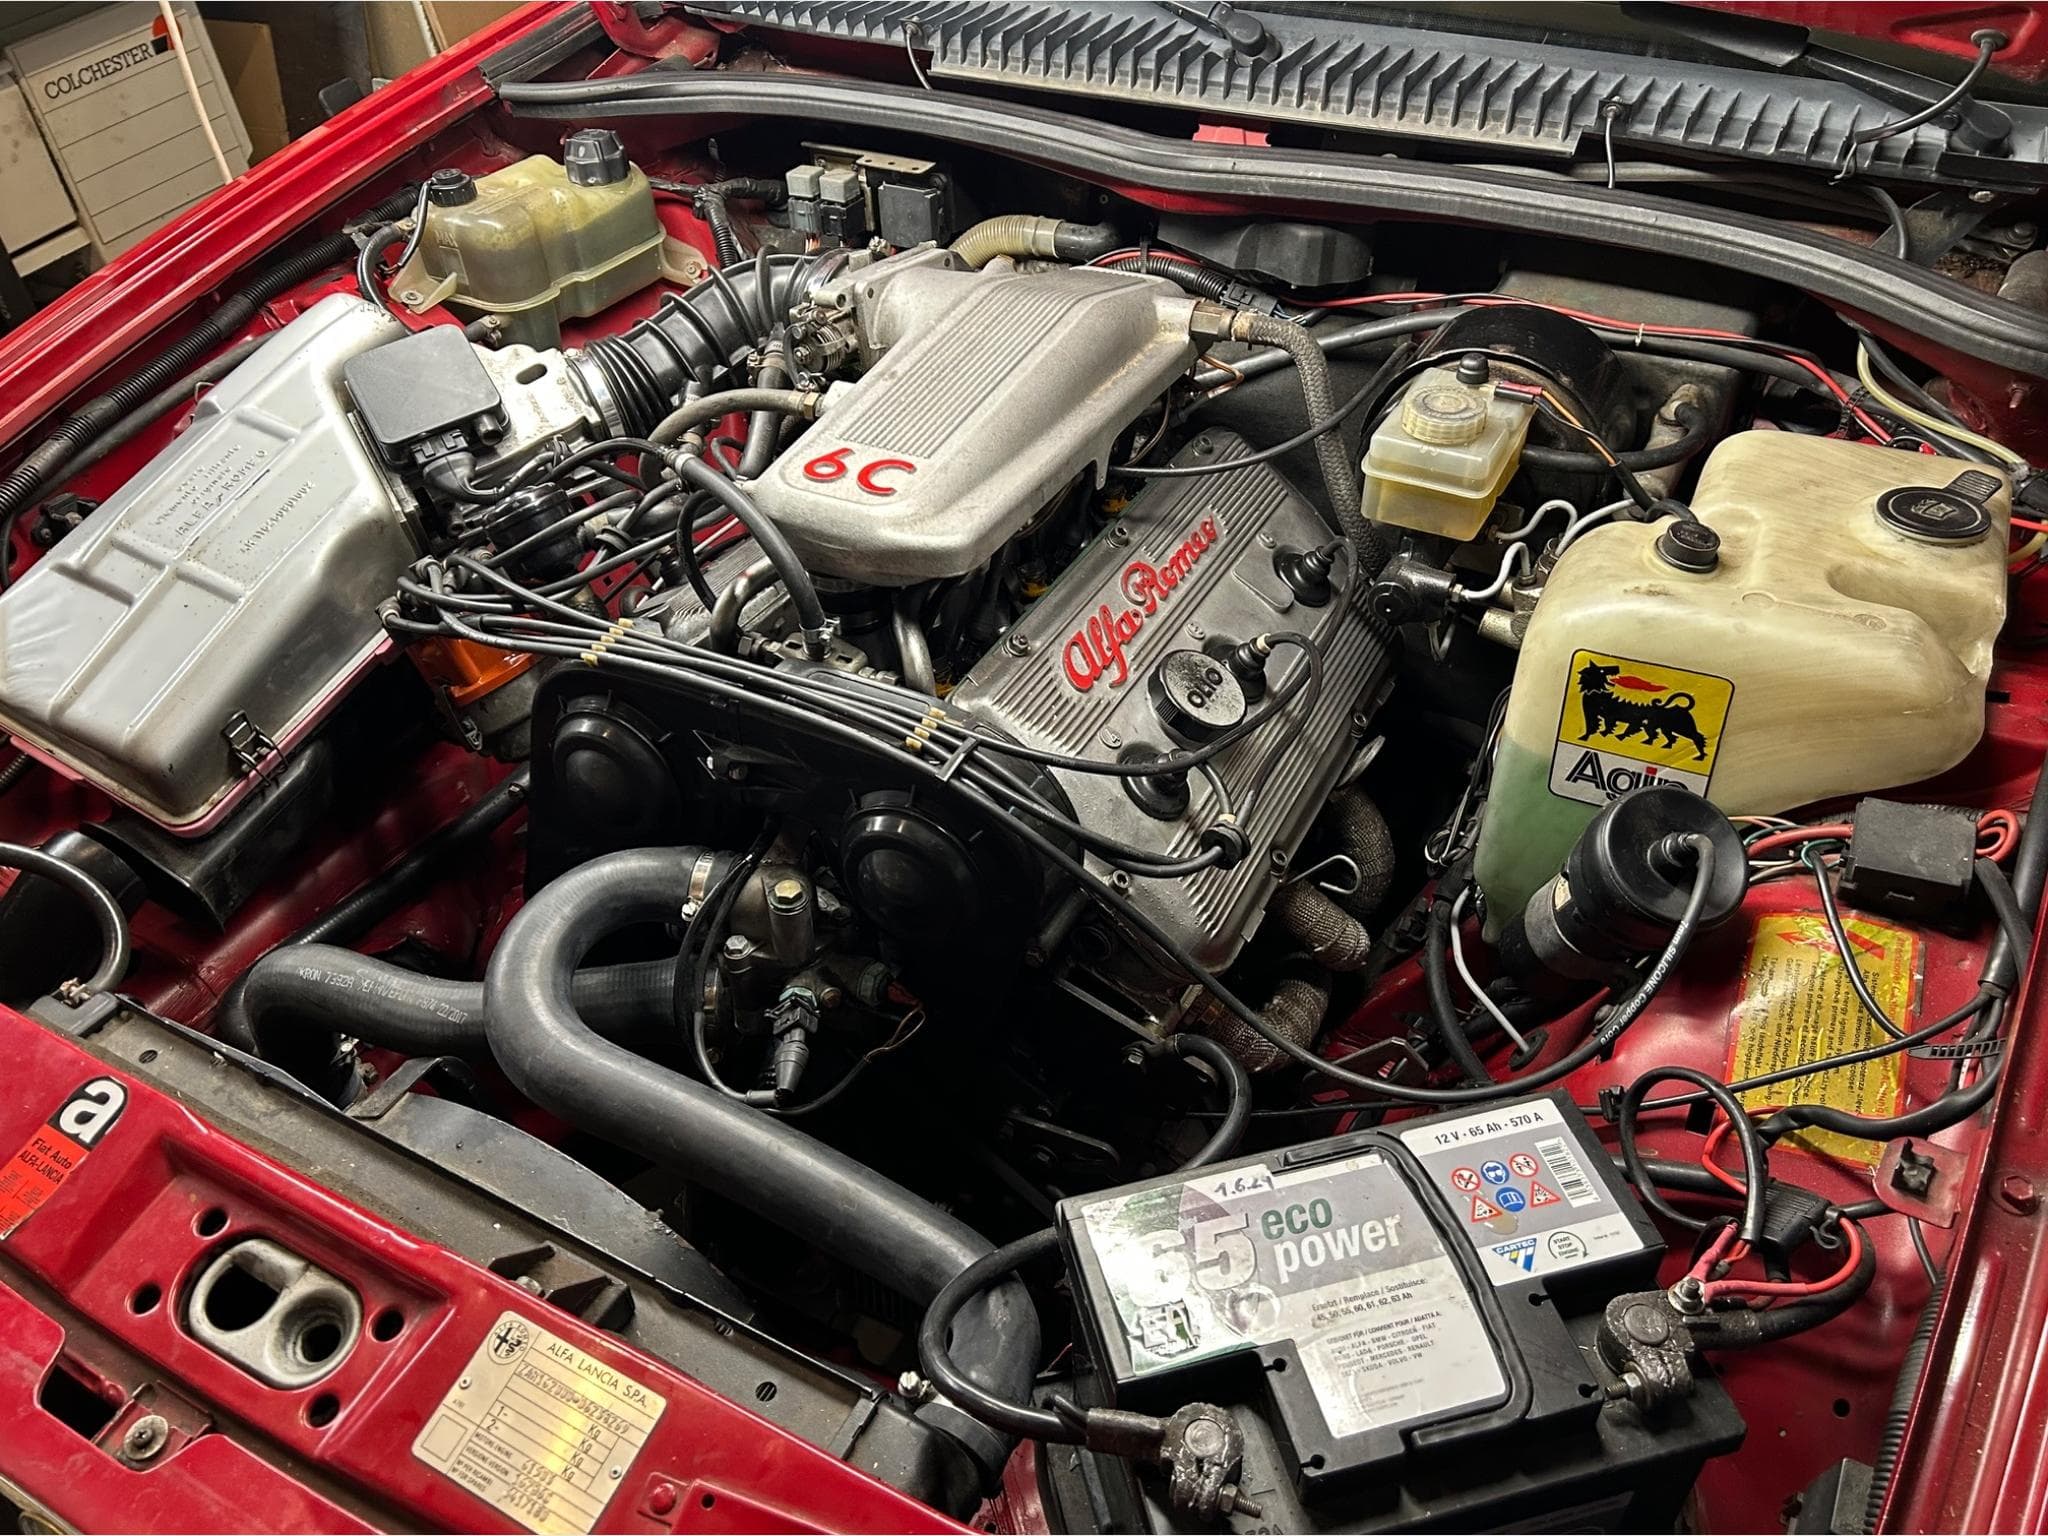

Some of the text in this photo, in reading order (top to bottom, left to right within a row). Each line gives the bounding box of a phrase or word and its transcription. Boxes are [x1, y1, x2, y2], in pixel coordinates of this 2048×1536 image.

[44, 42, 154, 100] COLCHESTER
[802, 447, 918, 497] 6C
[1062, 514, 1218, 692] Alfa Romeo
[1186, 667, 1223, 708] OLIO
[1600, 920, 1689, 1046] 7mm SILICONE Copper Core
[1832, 965, 1845, 1003] Dangerous
[1828, 1004, 1840, 1034] primary
[1839, 990, 1850, 1016] energy
[1775, 1022, 1784, 1037] und
[1826, 1035, 1835, 1050] and
[1835, 1017, 1847, 1046] ignition
[59, 1079, 125, 1144] a
[1434, 1112, 1544, 1146] 12 V 65 Ah 570 A
[17, 1150, 65, 1185] ALFA-LANCIA
[32, 1138, 73, 1170] Fiat Auto
[1261, 1198, 1333, 1240] eco
[1128, 1213, 1258, 1307] 65
[1272, 1214, 1401, 1284] power
[1496, 1239, 1536, 1254] CARTEC
[1343, 1288, 1380, 1304] Remplace
[1391, 1294, 1402, 1304] 63
[1402, 1292, 1413, 1300] Ah
[1376, 1340, 1404, 1352] PORSCHE
[547, 1343, 648, 1408] ALFA LANCIA S.P.A.
[580, 1438, 592, 1452] Kg
[588, 1424, 601, 1438] Kg
[562, 1466, 574, 1482] Kg
[570, 1452, 584, 1468] Kg
